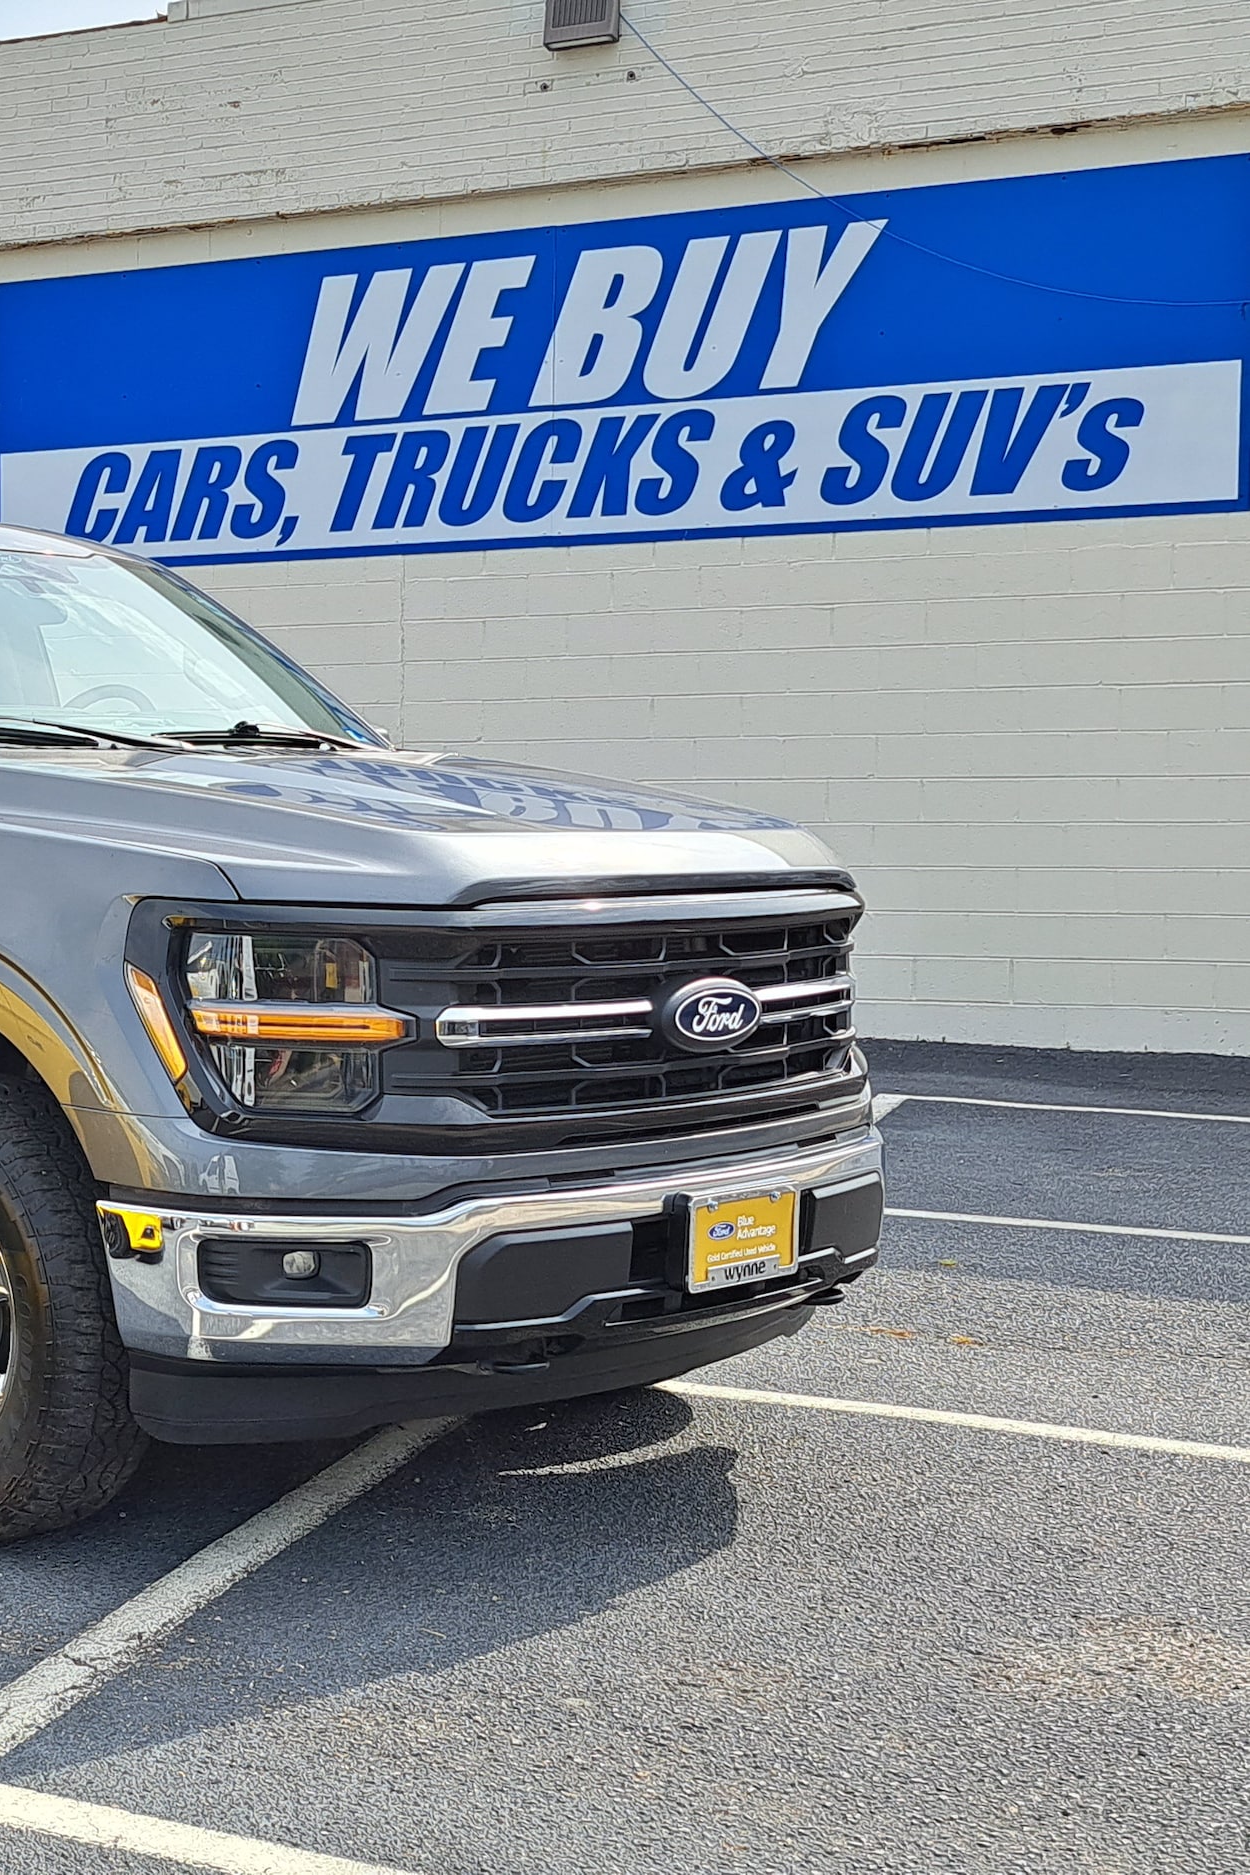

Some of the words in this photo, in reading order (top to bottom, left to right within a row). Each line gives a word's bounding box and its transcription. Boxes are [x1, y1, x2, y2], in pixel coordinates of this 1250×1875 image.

[291, 255, 536, 426] WE
[529, 219, 889, 406] BUY
[64, 439, 299, 547] CARS,
[329, 409, 715, 533] TRUCKS
[720, 420, 798, 511] &
[692, 997, 745, 1033] Ford
[737, 1215, 754, 1227] Blue
[737, 1224, 776, 1240] Advantage
[707, 1252, 720, 1263] Gold
[721, 1248, 743, 1260] Certified
[744, 1246, 757, 1256] Used
[758, 1243, 776, 1254] Vehicle
[724, 1260, 766, 1282] wynne
